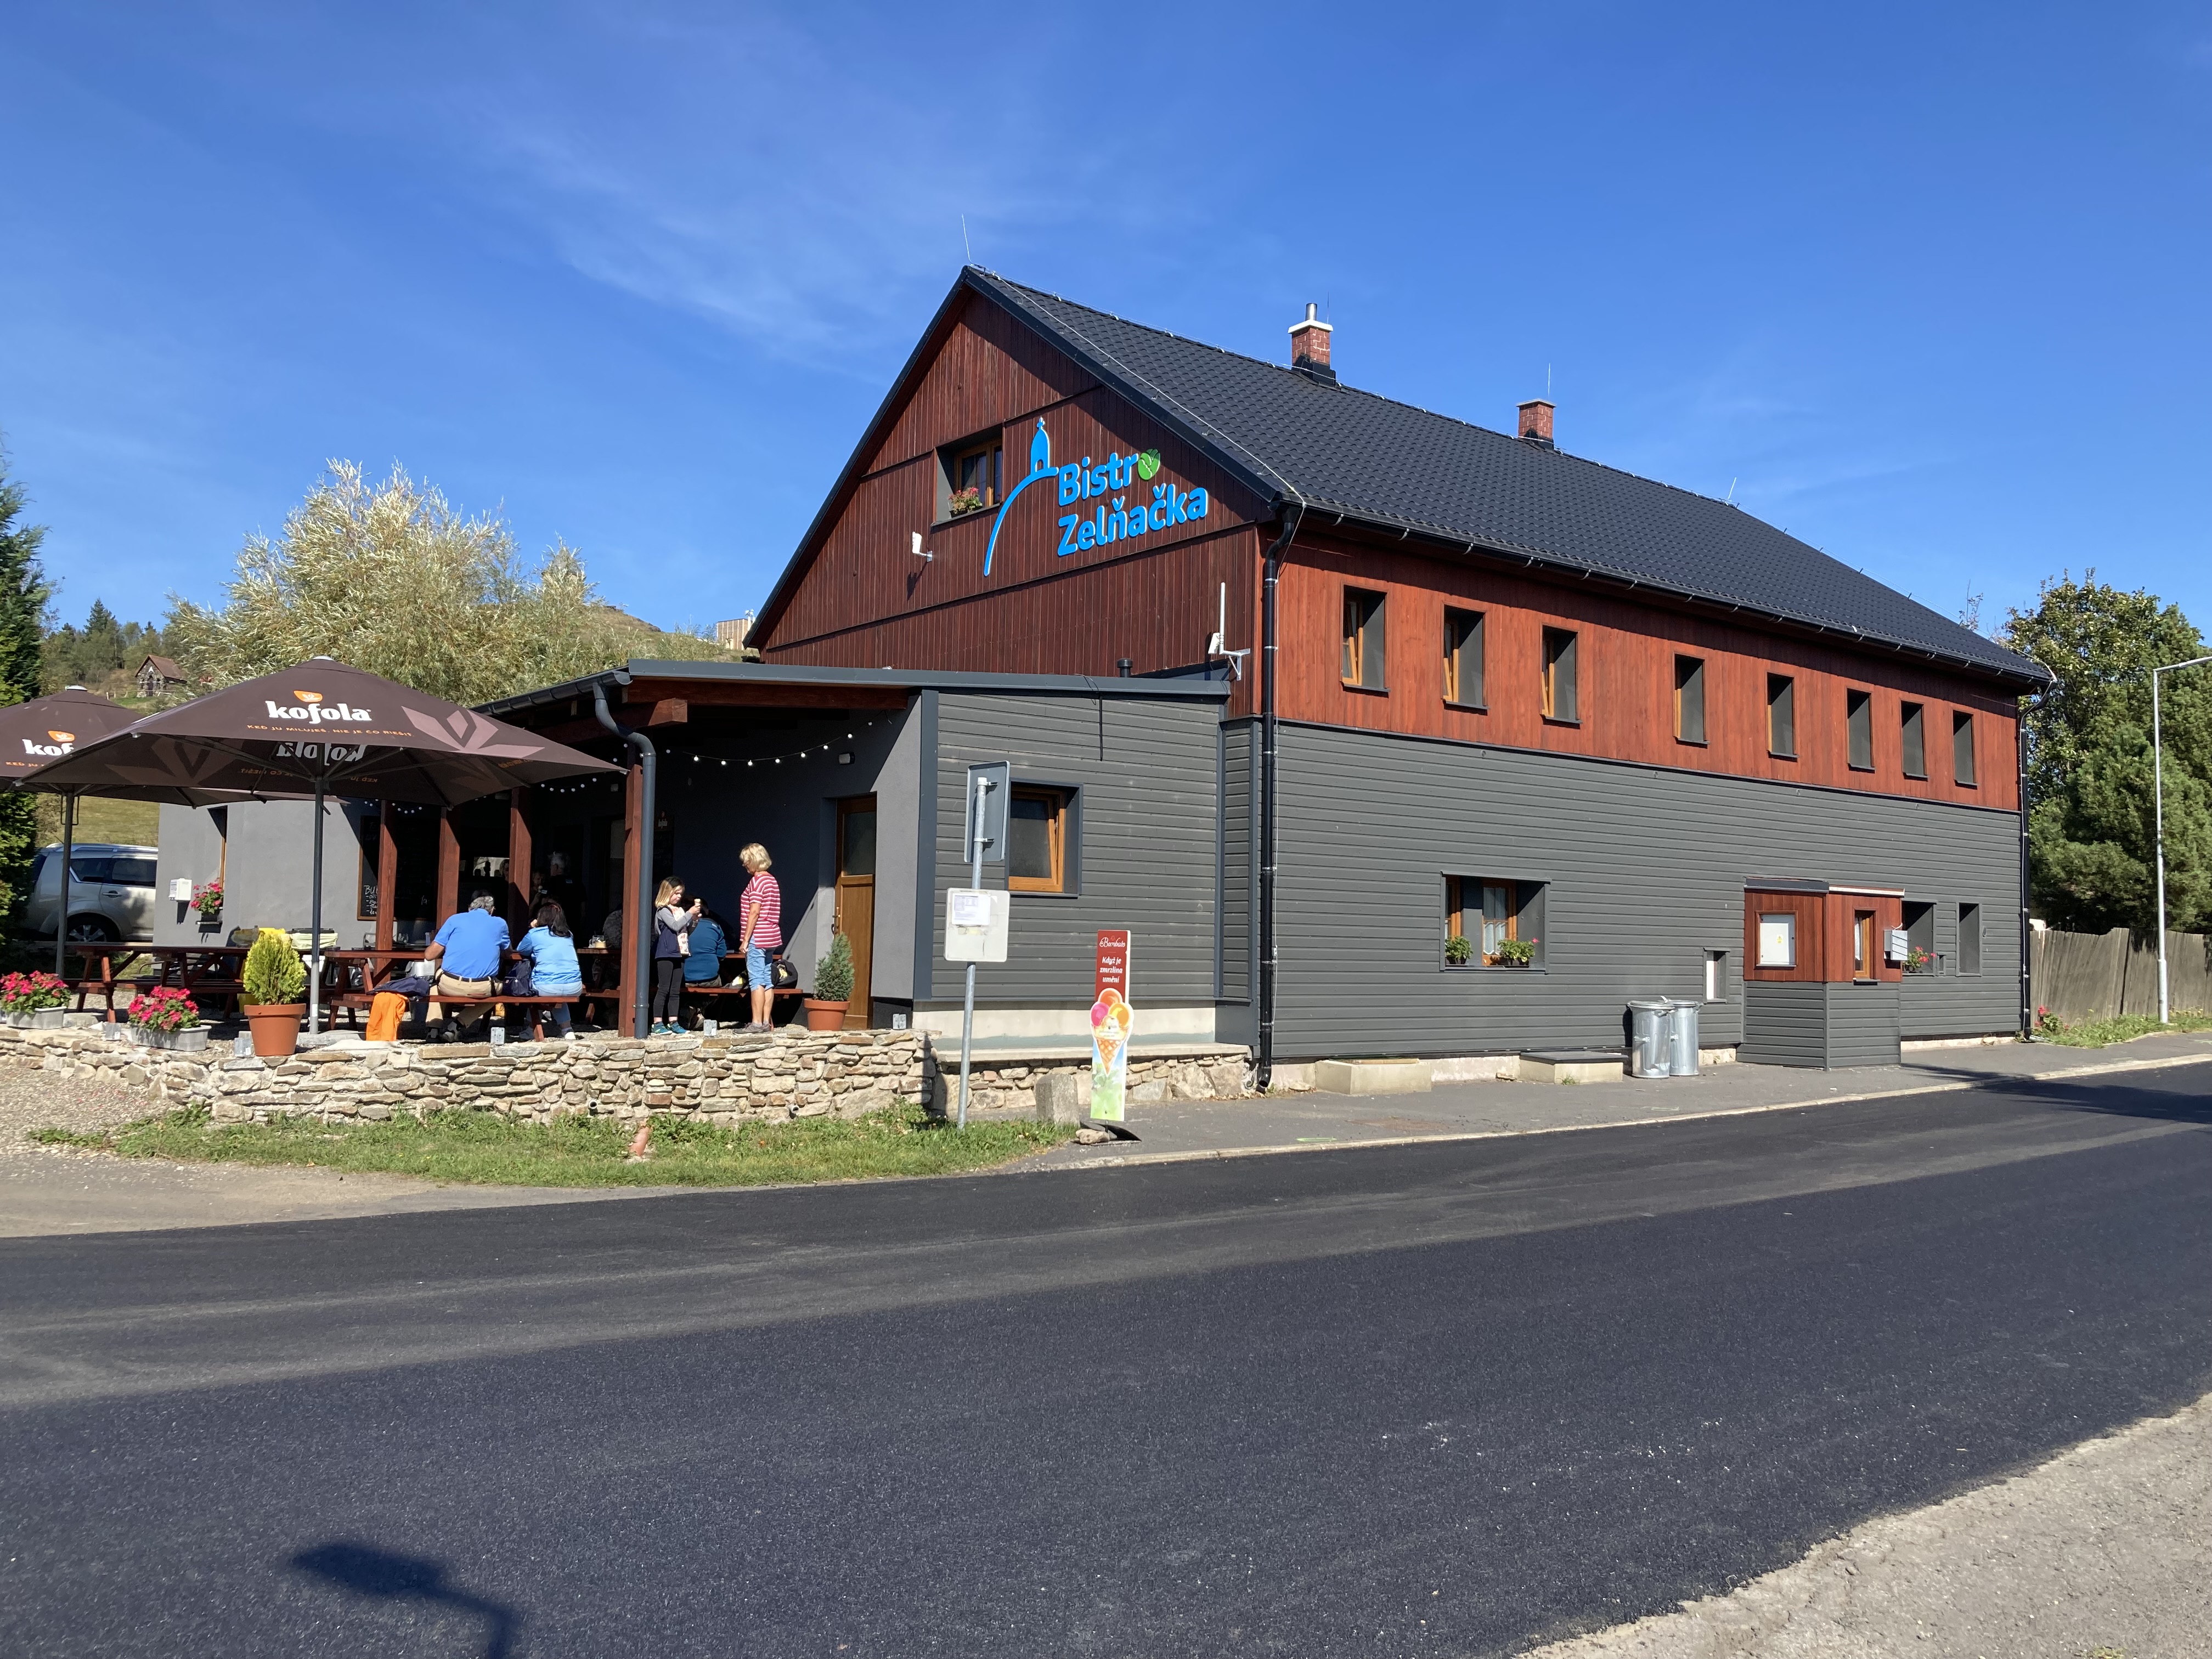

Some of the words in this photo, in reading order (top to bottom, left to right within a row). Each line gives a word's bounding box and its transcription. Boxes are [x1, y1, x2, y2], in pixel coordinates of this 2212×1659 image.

[1058, 483, 1208, 556] Zelňačka
[265, 701, 373, 724] kofola
[22, 738, 75, 756] kof
[1102, 956, 1115, 965] Když
